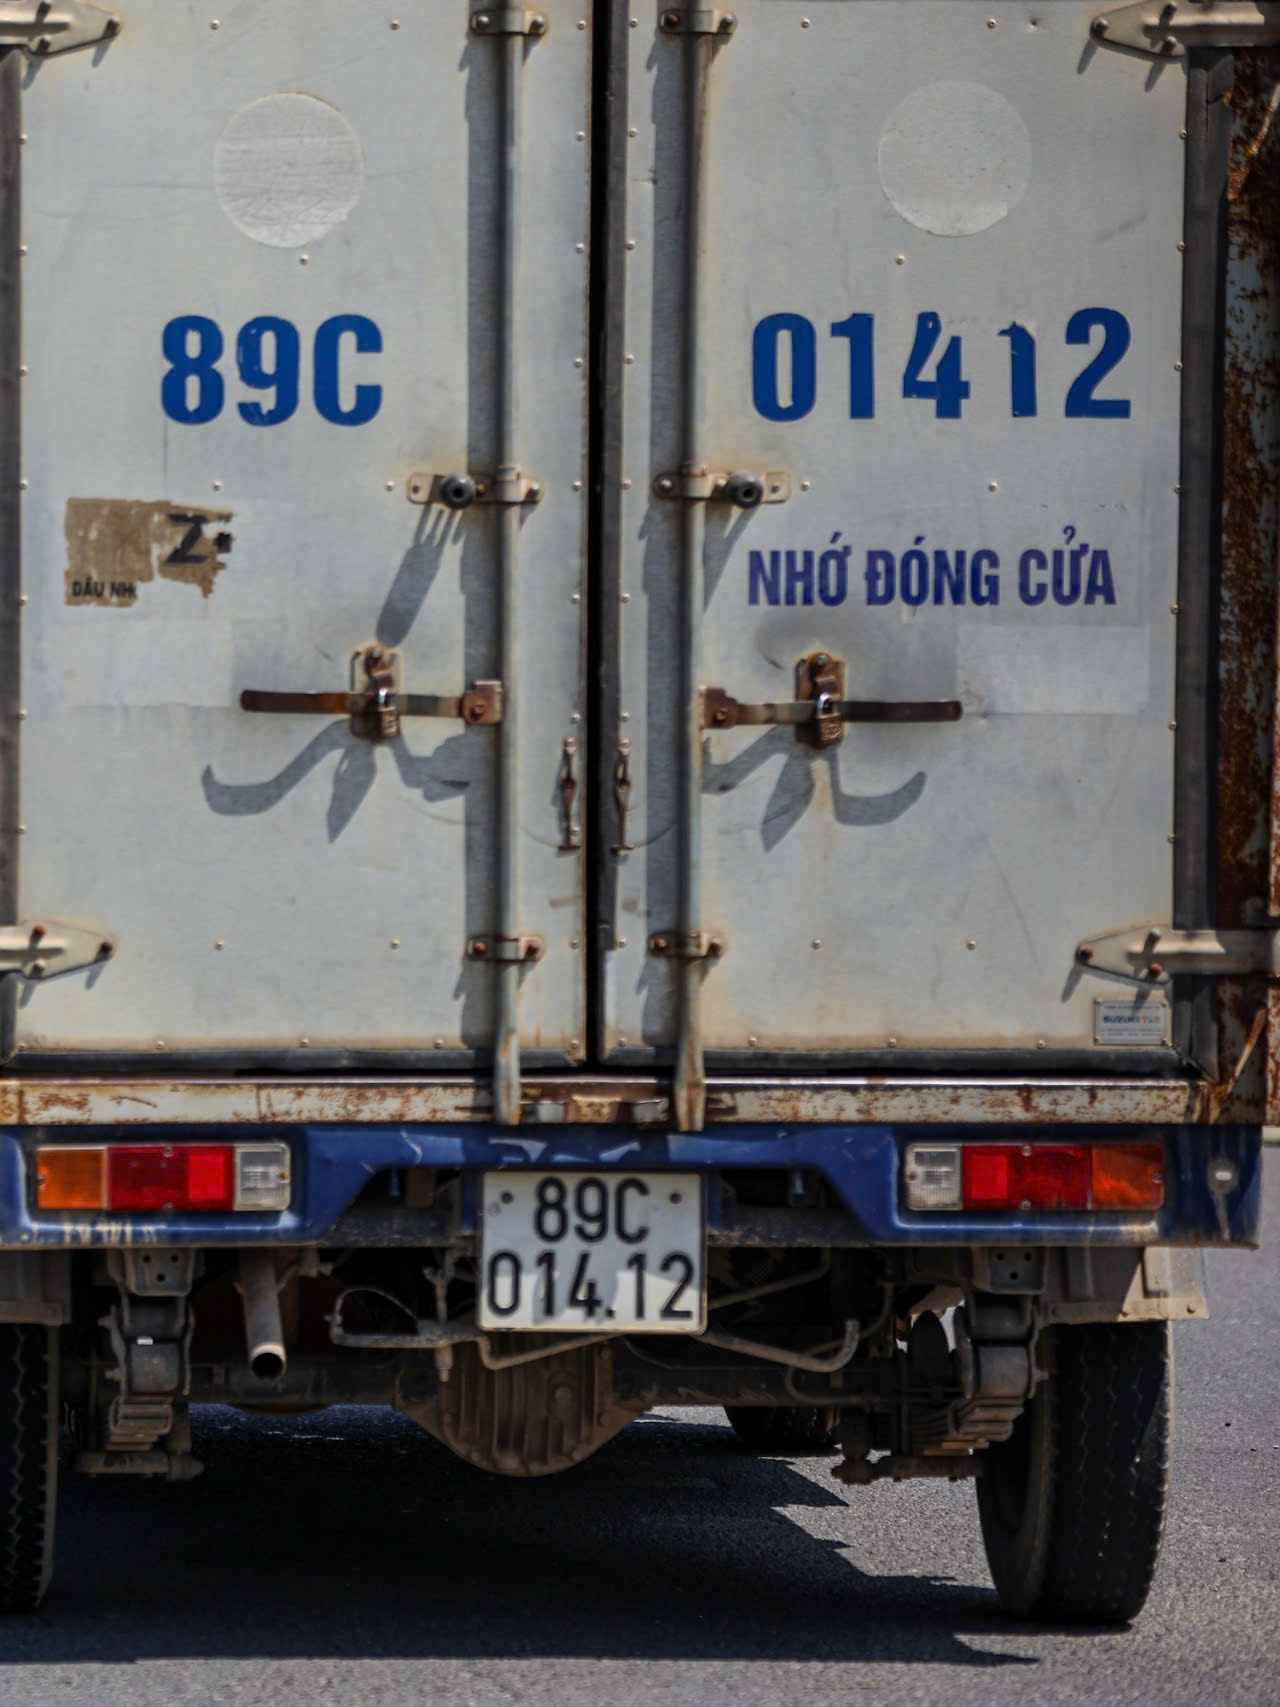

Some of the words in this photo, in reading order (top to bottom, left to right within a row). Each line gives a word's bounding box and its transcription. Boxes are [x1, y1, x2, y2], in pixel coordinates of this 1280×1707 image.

[161, 314, 383, 427] 89C
[752, 307, 1132, 422] 01412
[748, 531, 853, 606] NHỚ
[864, 536, 1001, 607] ĐÓNG
[1019, 525, 1118, 606] CỬA
[535, 1177, 650, 1244] 89C
[487, 1250, 695, 1320] 014.12
